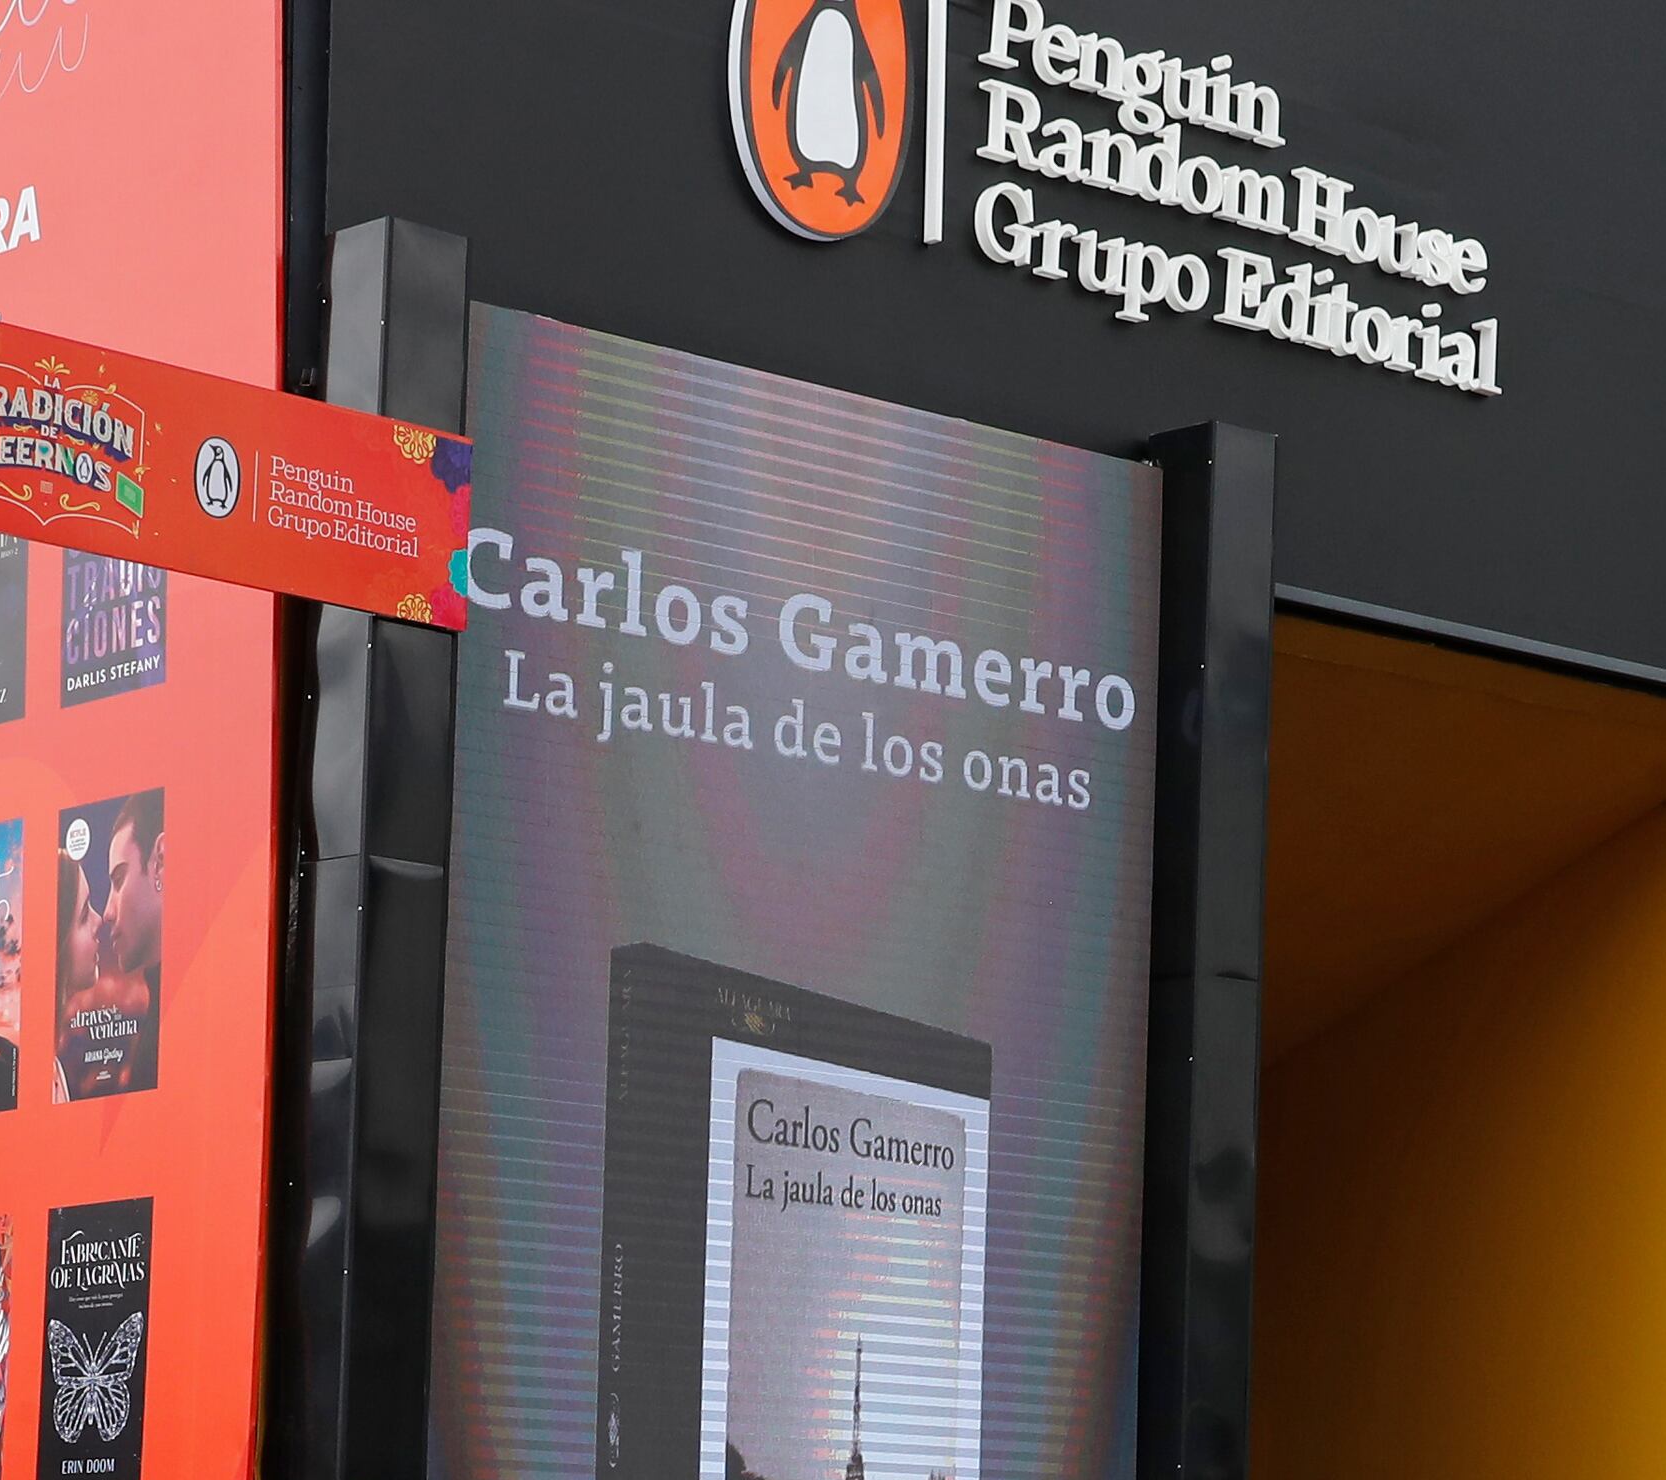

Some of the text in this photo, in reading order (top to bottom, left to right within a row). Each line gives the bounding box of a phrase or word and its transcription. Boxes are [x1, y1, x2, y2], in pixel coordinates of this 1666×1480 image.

[978, 0, 1285, 148] Penguin
[976, 79, 1488, 299] Random House
[974, 182, 1501, 397] Grupo Editorial
[44, 376, 61, 389] LA
[40, 424, 58, 439] DE
[270, 455, 354, 494] Penguin
[267, 506, 419, 558] Grupo Editorial
[269, 480, 417, 533] Random House
[468, 528, 1135, 730] Carlos Gamerro
[67, 655, 161, 692] DARLIS STEFANY
[503, 649, 1091, 811] La jaula de los onas
[747, 1099, 954, 1170] Carlos Gamerro
[61, 1457, 115, 1474] ERIN DOOM
